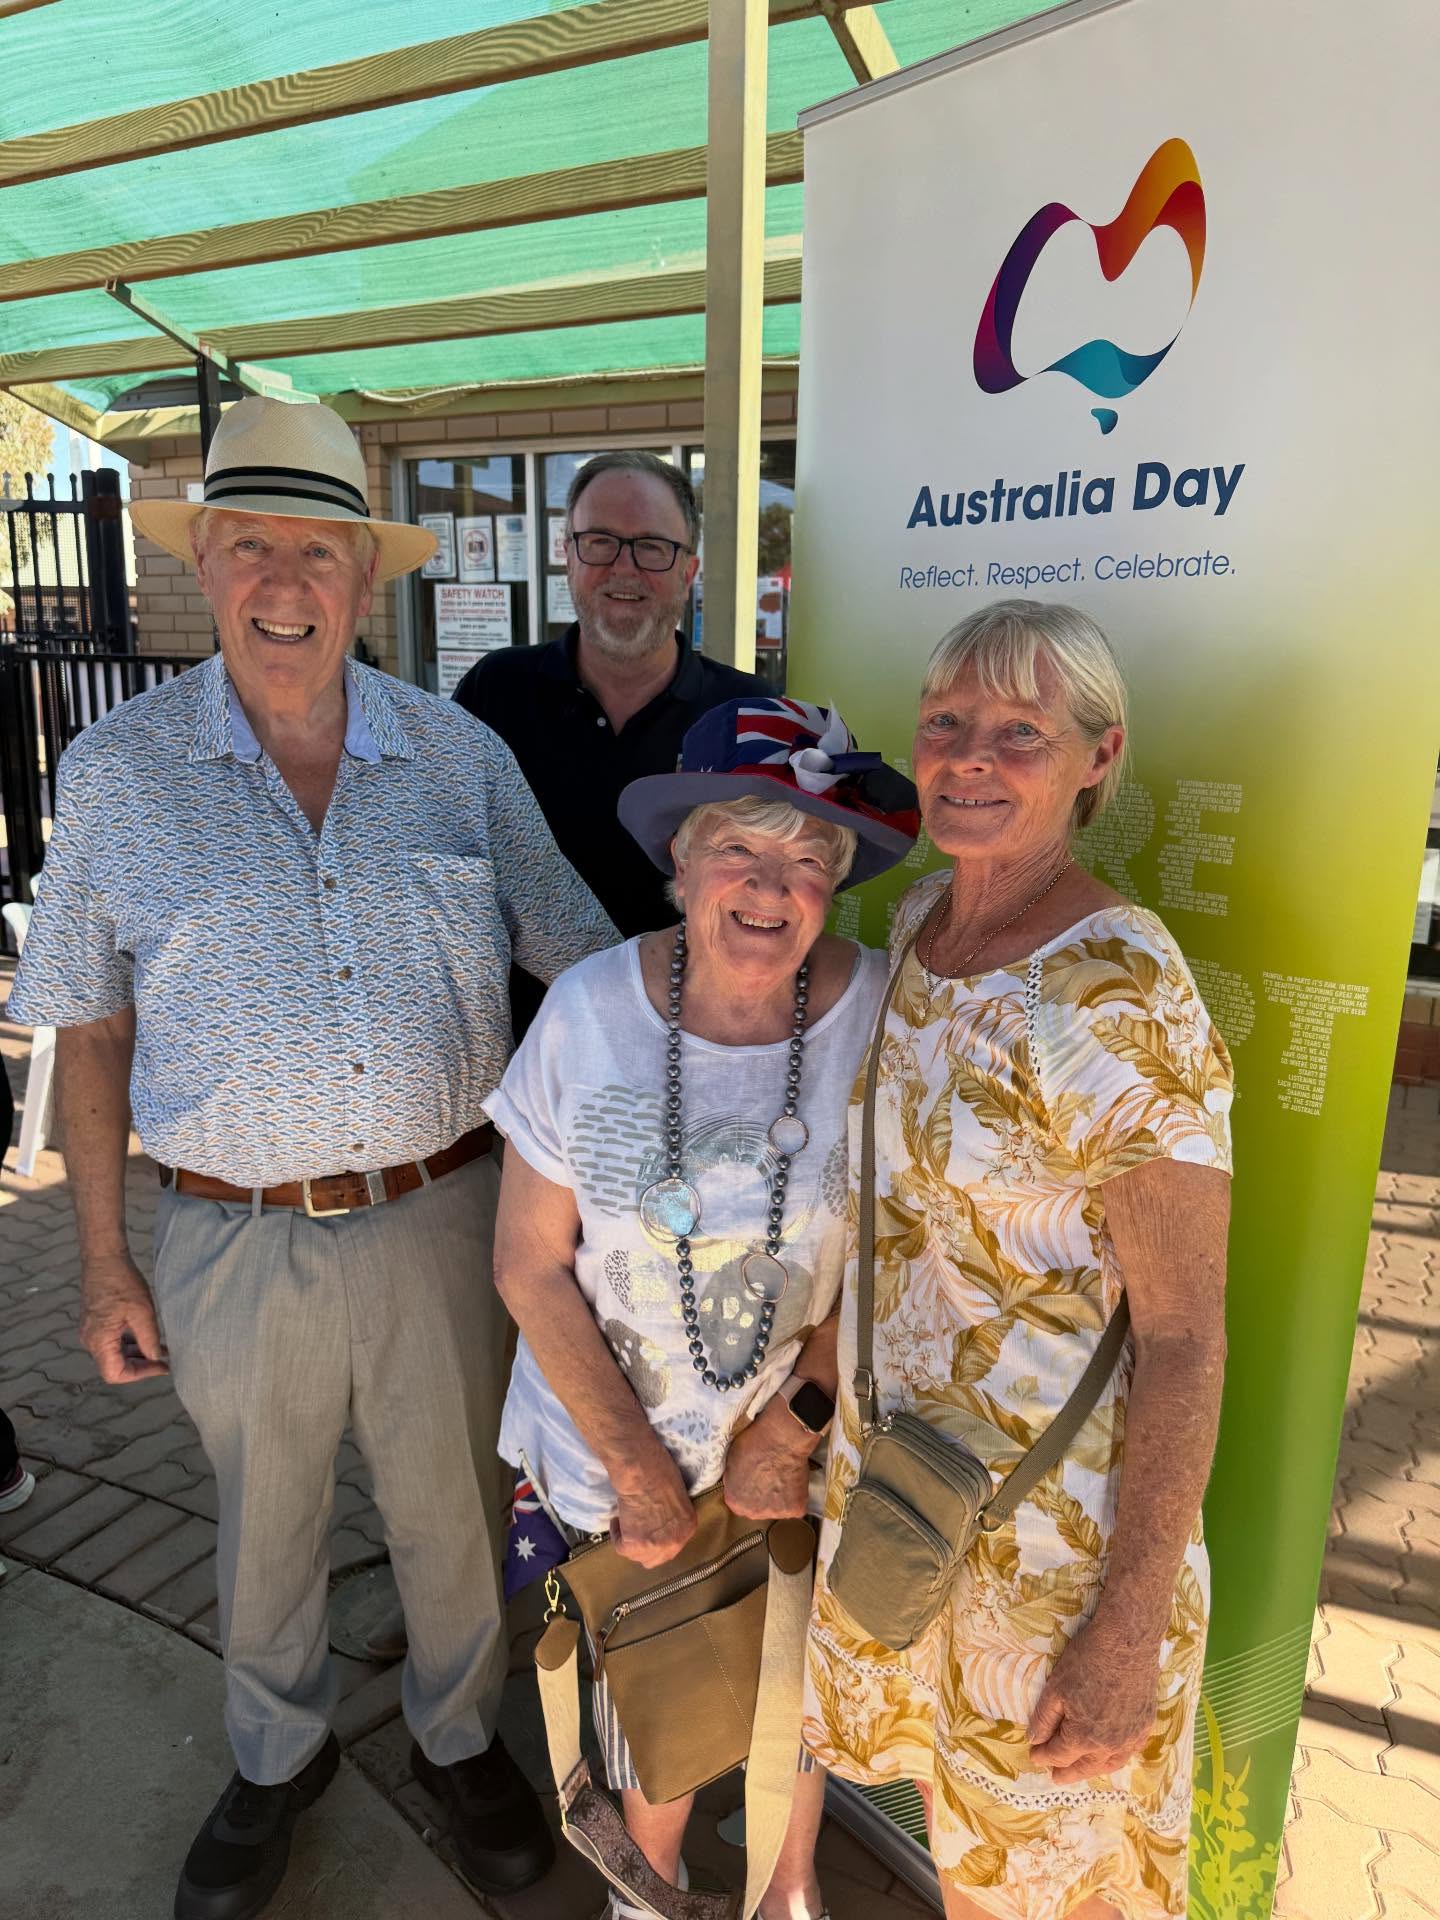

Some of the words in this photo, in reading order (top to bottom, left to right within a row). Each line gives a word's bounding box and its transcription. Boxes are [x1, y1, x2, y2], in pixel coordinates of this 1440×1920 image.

[906, 469, 1116, 529] Australia
[1132, 461, 1246, 516] Day
[900, 564, 979, 589] Reflect.
[987, 558, 1085, 590] Respect.
[1094, 550, 1236, 582] Celebrate.
[441, 588, 471, 599] SAFETY
[474, 589, 504, 599] WATCH
